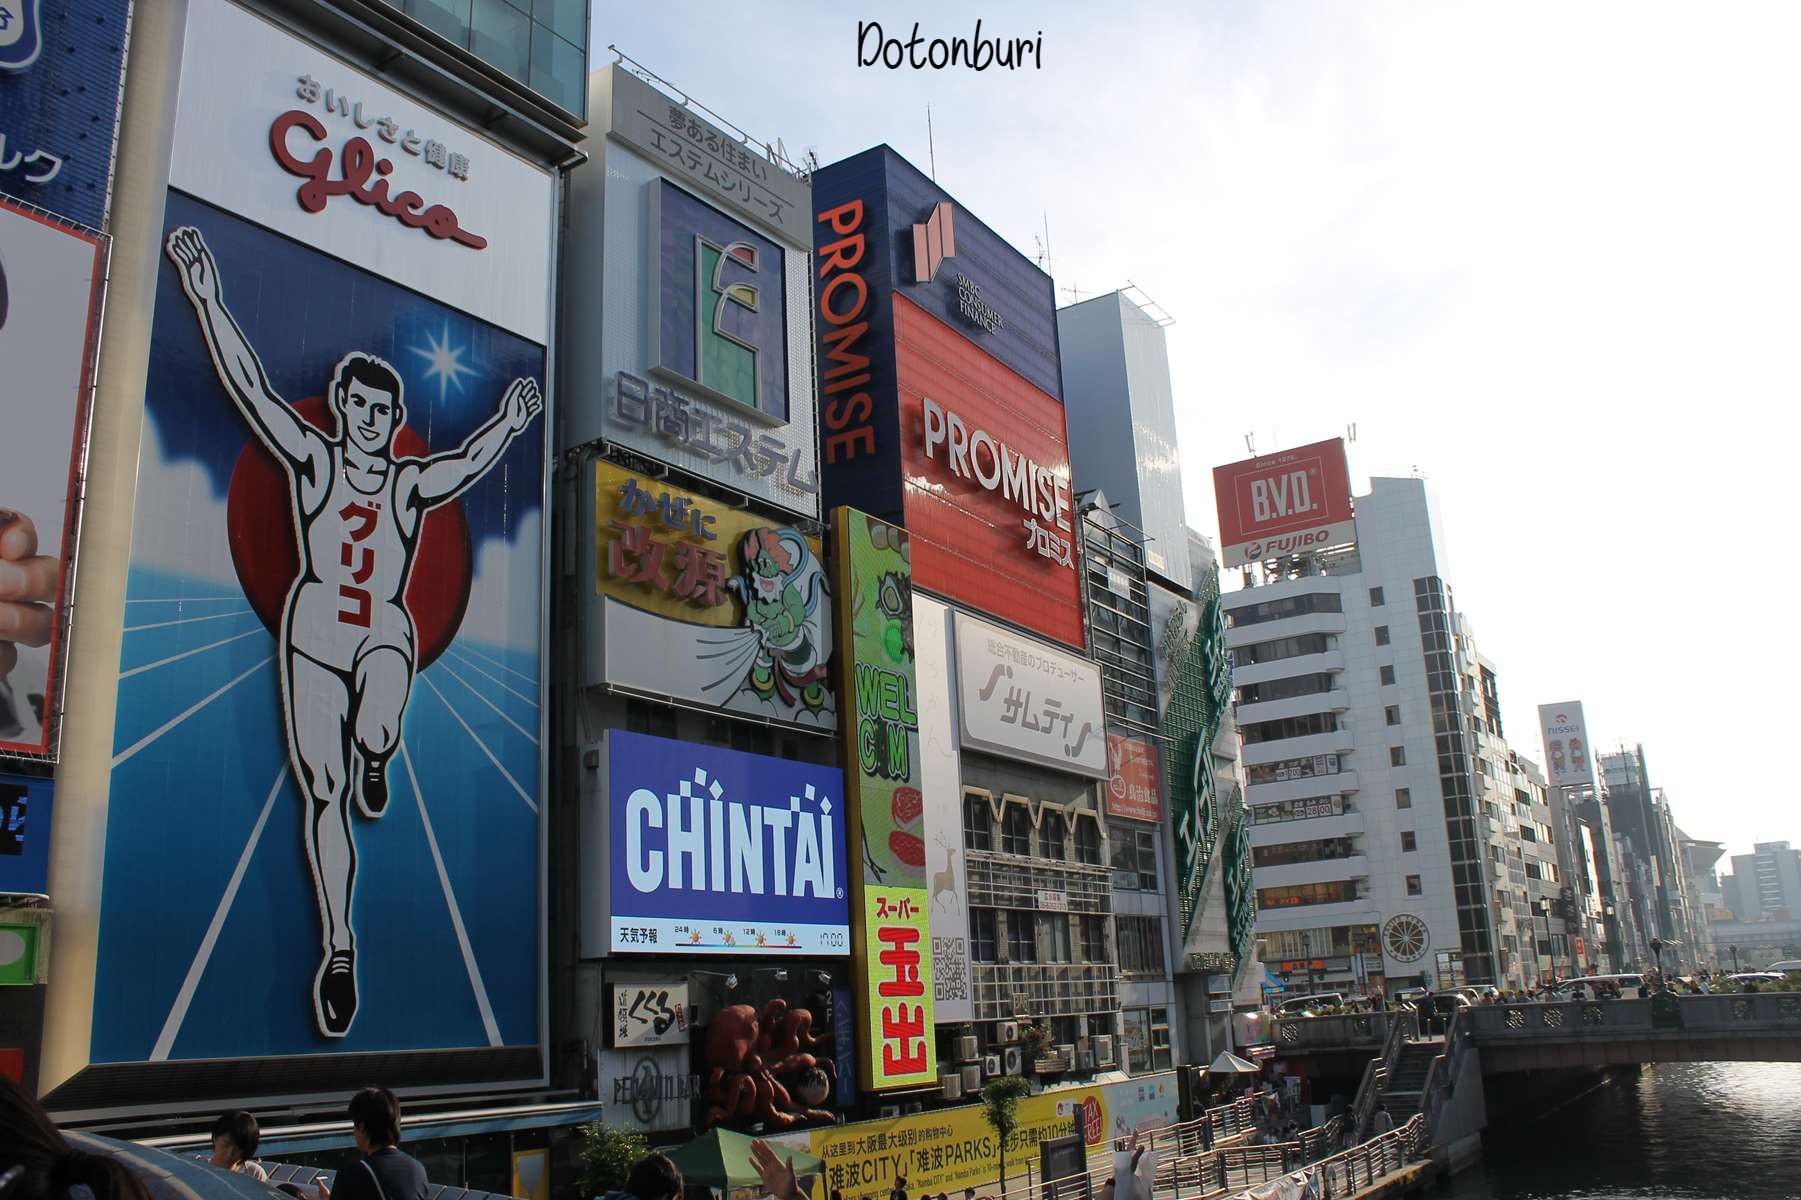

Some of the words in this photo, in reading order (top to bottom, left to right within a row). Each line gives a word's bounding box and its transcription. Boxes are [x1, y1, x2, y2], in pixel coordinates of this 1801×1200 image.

[296, 74, 471, 181] おいしさと健康
[668, 105, 768, 182] 夢ある住まい
[269, 109, 488, 250] Glico
[650, 128, 785, 225] エステムシリーズ
[957, 272, 982, 300] SMBC
[958, 286, 1004, 329] CONSUMER
[960, 299, 997, 336] FINANCE
[818, 199, 875, 465] PROMISE
[924, 397, 1072, 533] PROMISE
[1251, 470, 1318, 522] B.V.D.
[619, 478, 718, 541] かぜに
[1266, 530, 1329, 553] FUJIBO
[337, 500, 382, 629] グリコ
[607, 519, 727, 608] 改源
[1023, 518, 1075, 570] プロミス
[855, 662, 918, 727] WEL
[1000, 685, 1075, 740] サムティ
[858, 717, 911, 782] CM
[626, 767, 836, 899] CHINTAI
[620, 927, 658, 944] 天気予報
[876, 897, 920, 920] スーパー
[628, 990, 676, 1036] くくる
[878, 926, 928, 1077] 玉出
